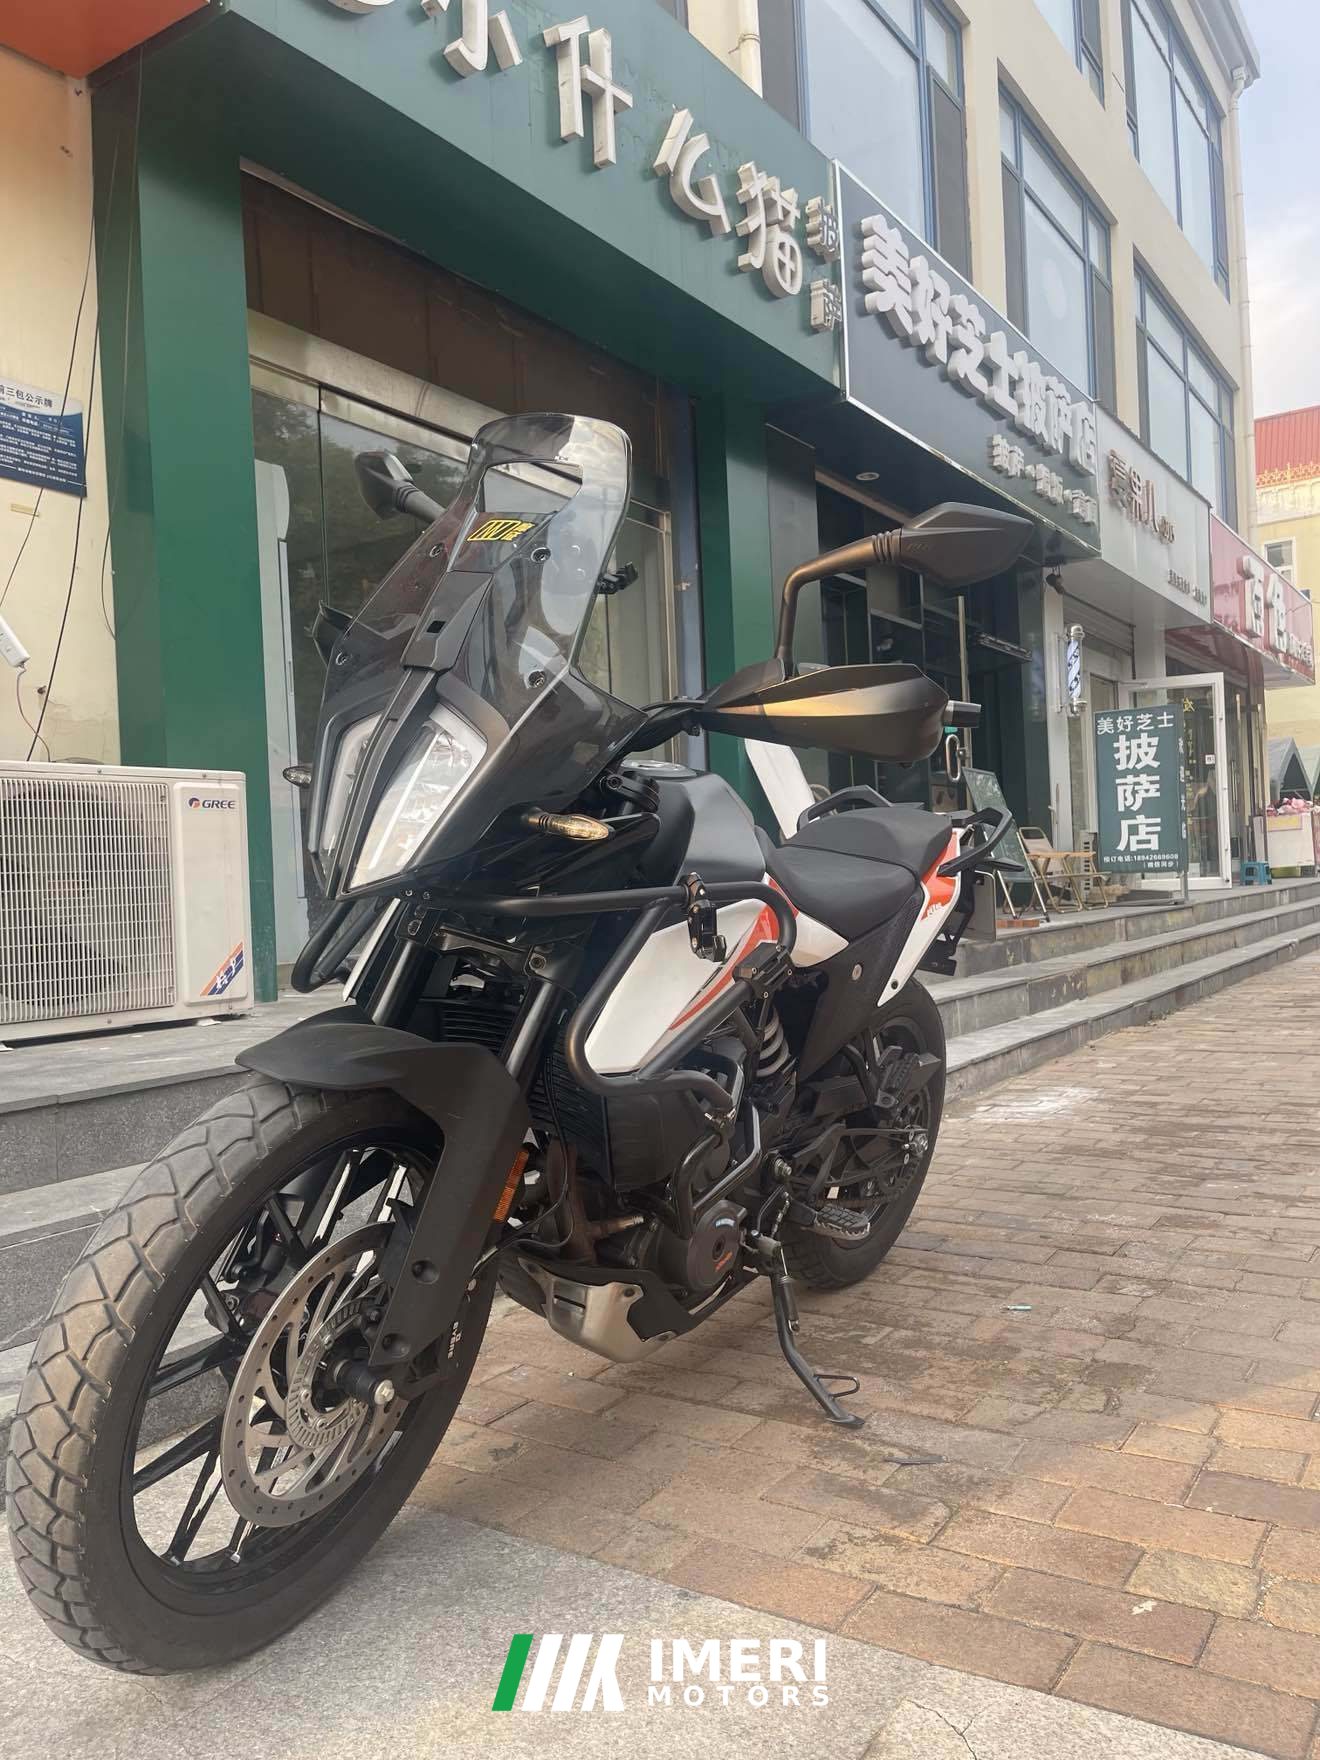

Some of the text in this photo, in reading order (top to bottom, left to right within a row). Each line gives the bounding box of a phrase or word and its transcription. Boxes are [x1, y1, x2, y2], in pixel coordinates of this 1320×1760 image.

[861, 214, 1096, 476] 美好芝士披萨店
[1097, 711, 1174, 735] 美好芝士
[202, 799, 236, 809] GREE
[1113, 732, 1161, 852] 披萨店
